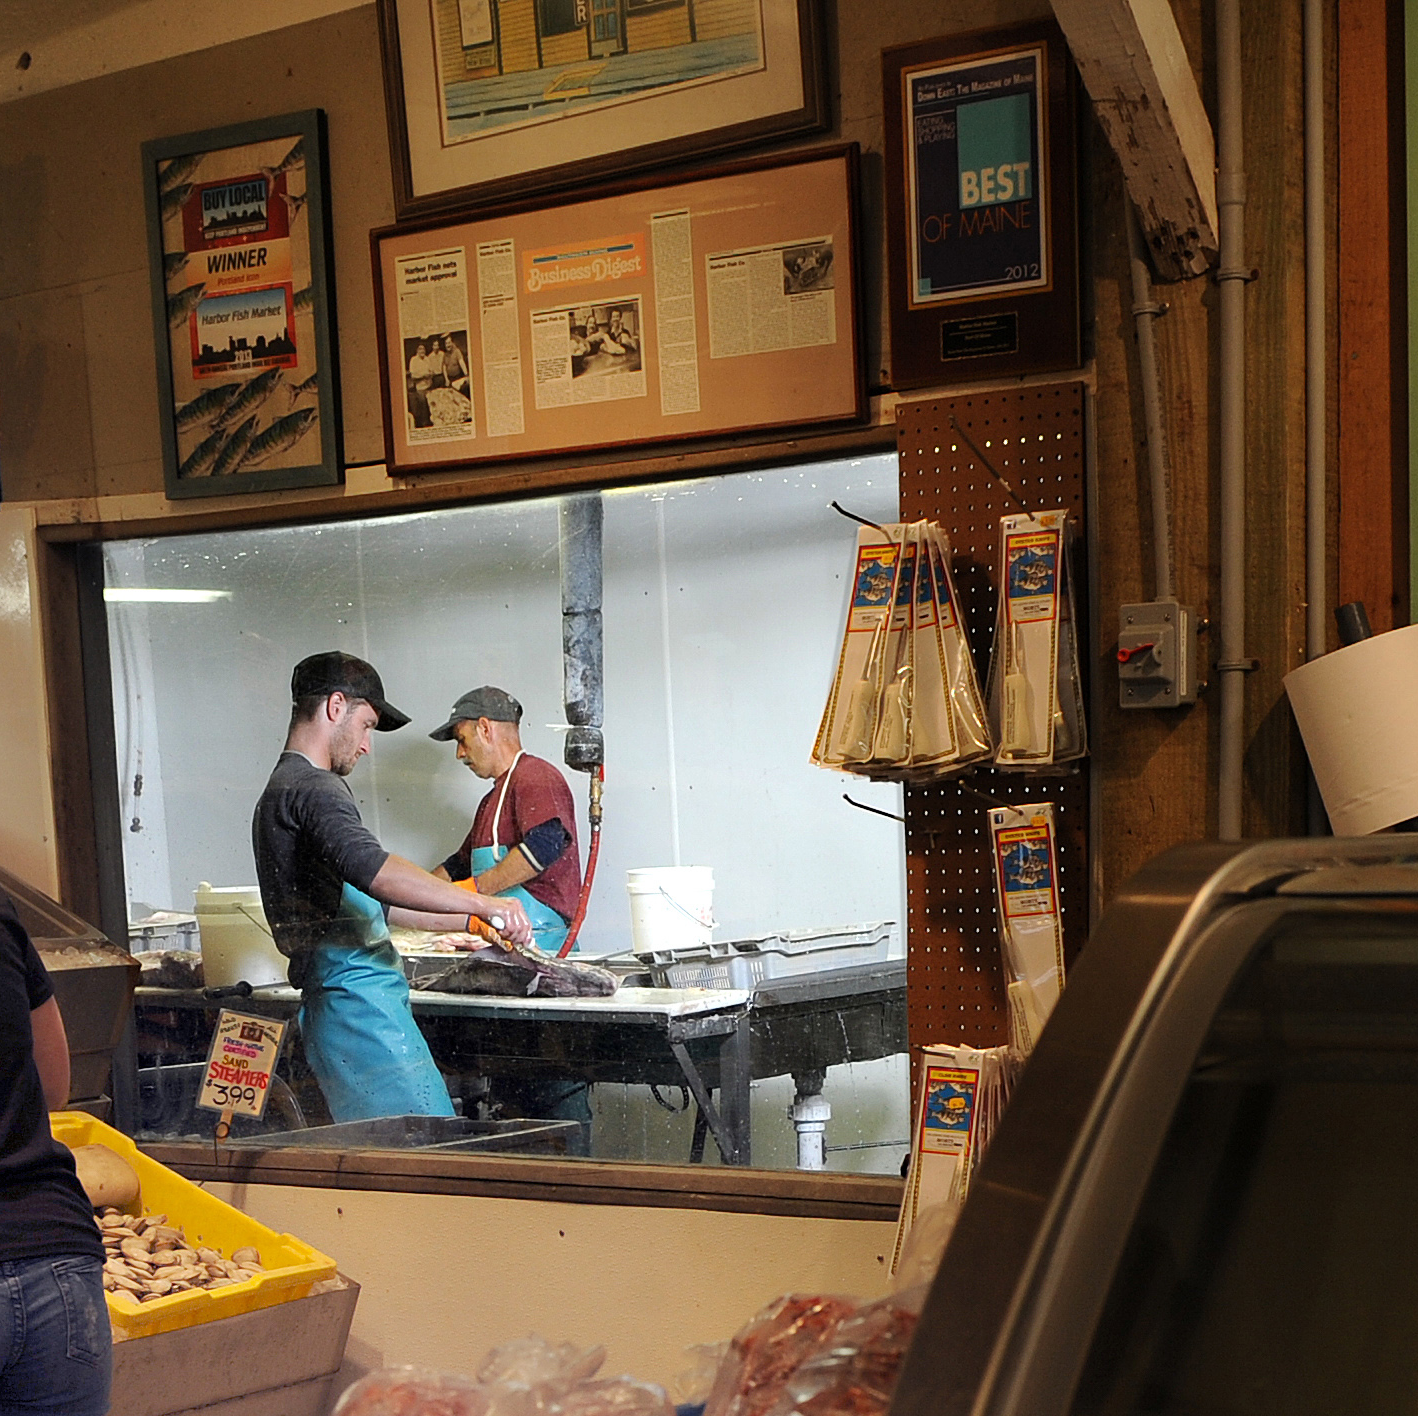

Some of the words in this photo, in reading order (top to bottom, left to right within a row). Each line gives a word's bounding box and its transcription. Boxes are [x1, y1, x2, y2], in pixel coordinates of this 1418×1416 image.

[203, 189, 227, 212] BUY
[229, 183, 265, 207] LOCAL
[960, 161, 1031, 207] BEST
[922, 213, 952, 244] OF
[958, 200, 1031, 239] MAINE
[207, 247, 267, 275] WINNER
[404, 265, 427, 276] Harbor
[427, 262, 441, 272] Fish
[526, 264, 592, 292] Business
[591, 255, 642, 281] Digest
[1004, 263, 1040, 282] 2012
[405, 275, 429, 285] market
[430, 270, 458, 282] approval
[201, 312, 231, 326] Harbor
[232, 309, 250, 322] Fish
[251, 305, 282, 319] Market
[208, 1061, 269, 1090] STEAMERS
[221, 1054, 249, 1070] SAND
